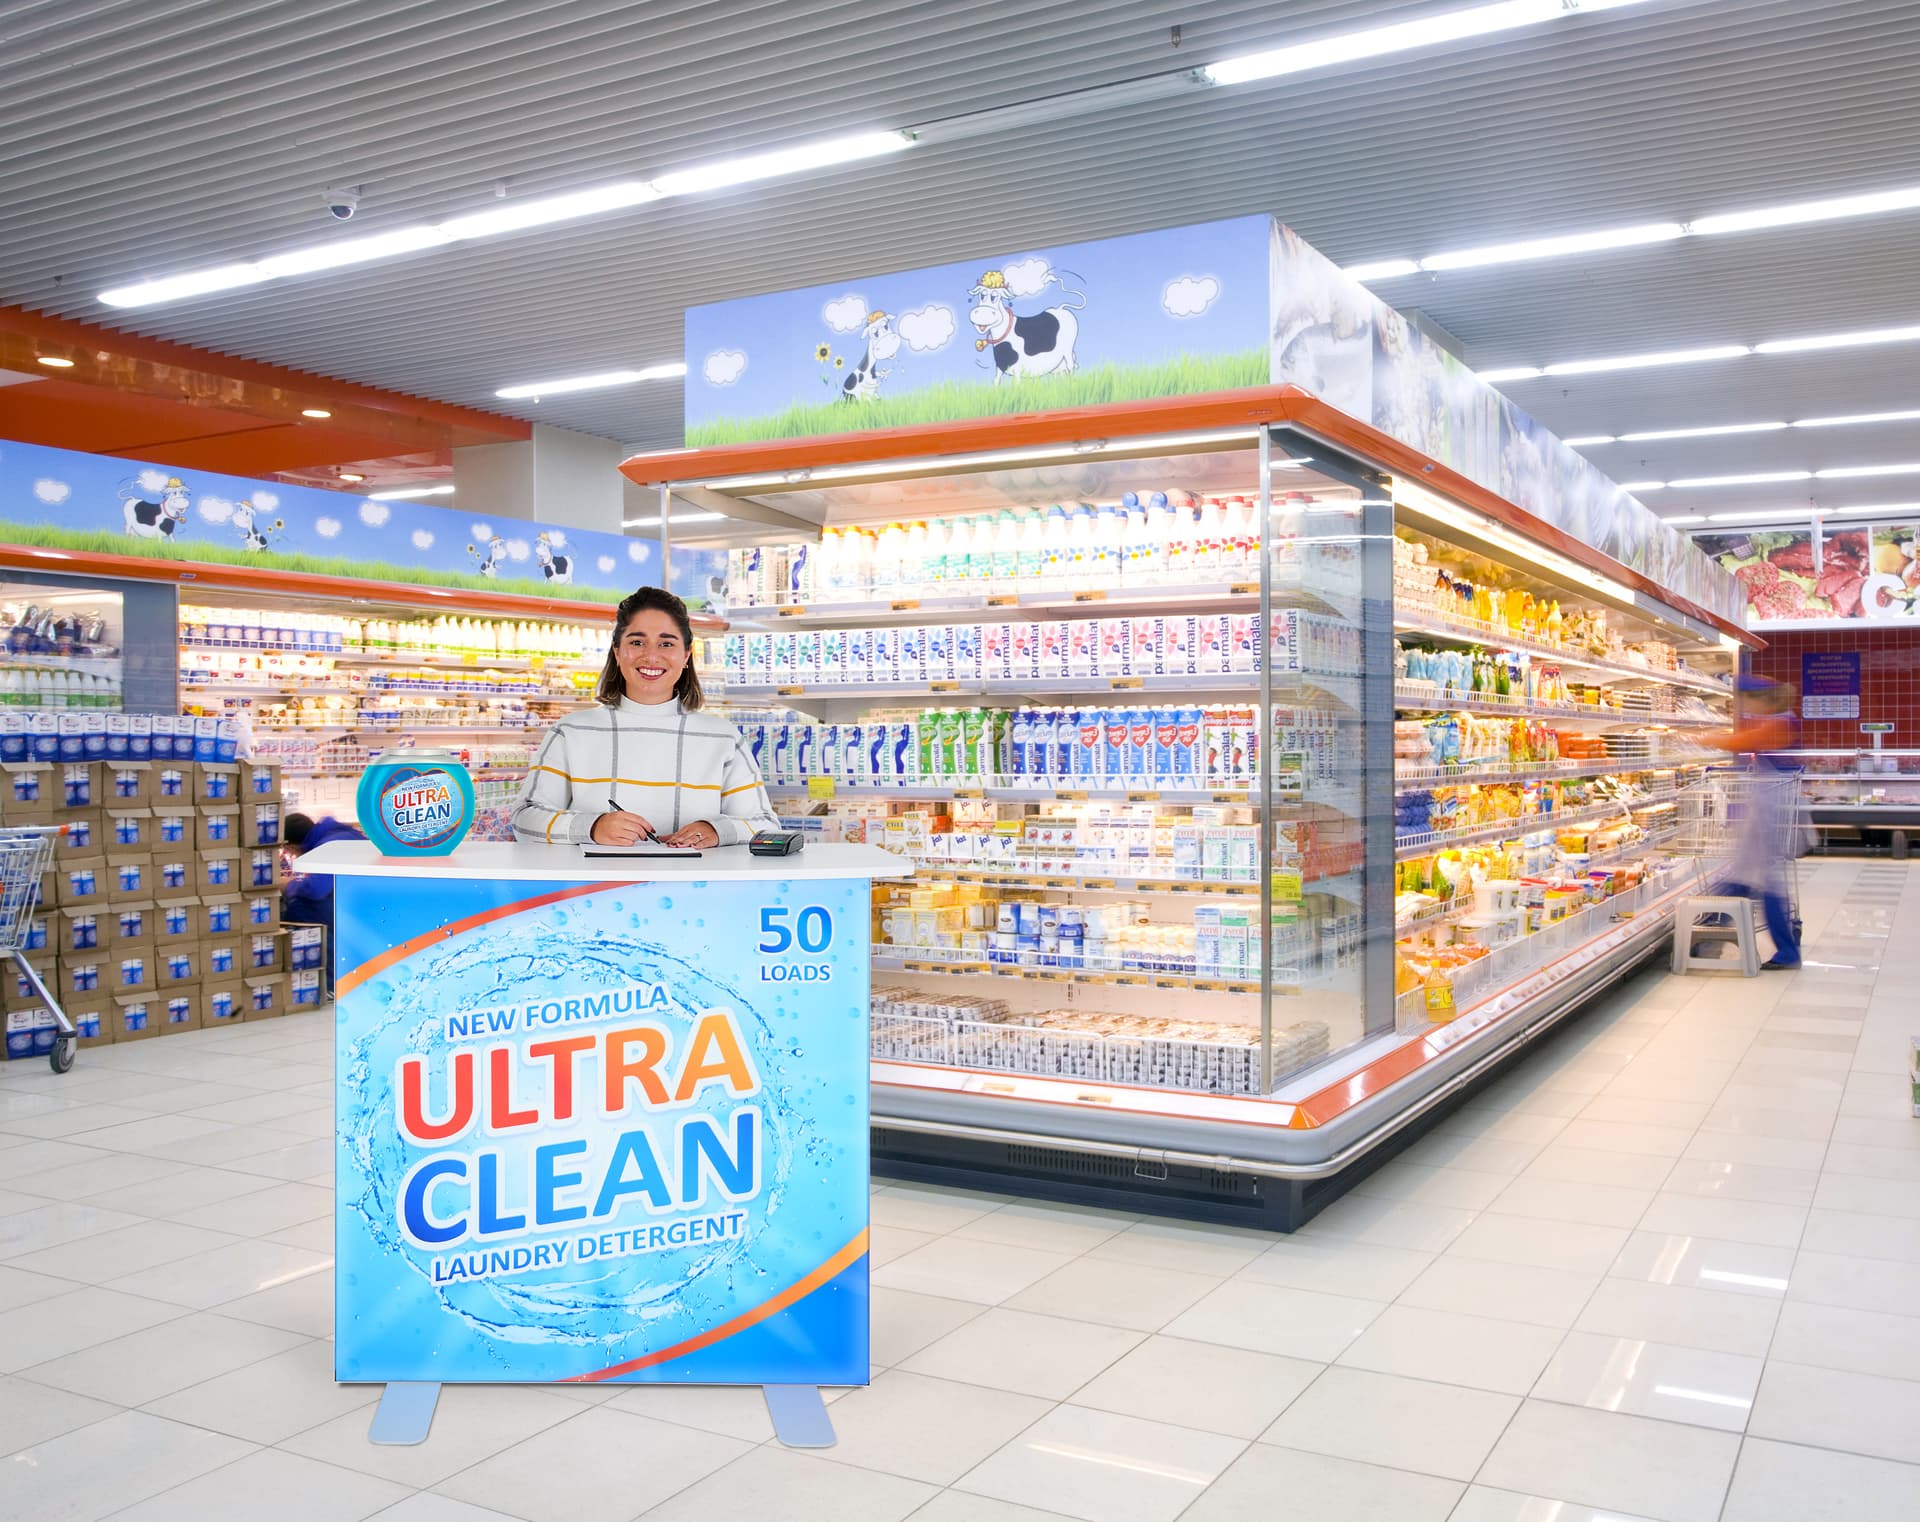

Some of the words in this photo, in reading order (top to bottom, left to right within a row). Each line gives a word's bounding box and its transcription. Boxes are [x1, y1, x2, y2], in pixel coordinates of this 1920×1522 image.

[394, 787, 450, 809] ULTRA
[394, 803, 450, 826] CLEAN
[759, 905, 832, 954] 50
[760, 964, 831, 982] LOADS
[449, 1008, 516, 1038] NEW
[526, 986, 669, 1026] FORMULA
[402, 1013, 754, 1140] ULTRA
[403, 1113, 754, 1243] CLEAN
[435, 1240, 569, 1282] LAUNDRY
[579, 1214, 744, 1259] DETERGENT
